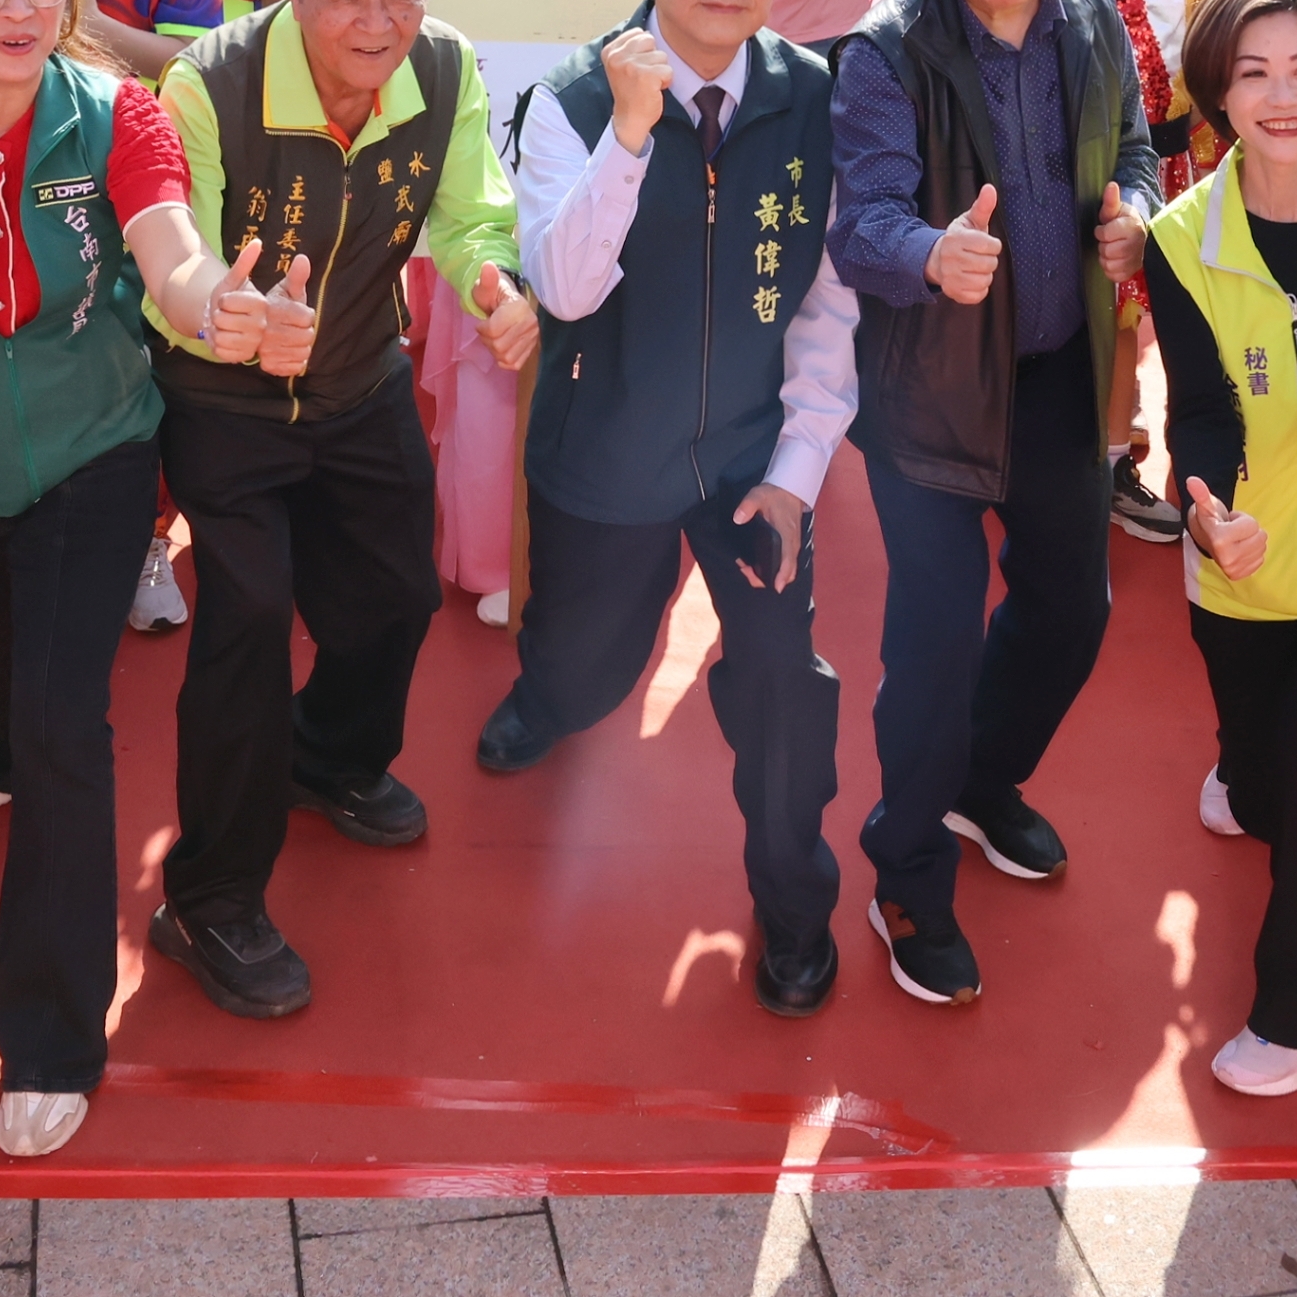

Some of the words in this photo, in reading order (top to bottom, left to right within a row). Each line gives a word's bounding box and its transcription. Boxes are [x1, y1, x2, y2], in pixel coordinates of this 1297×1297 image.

[54, 181, 96, 198] DPP
[785, 156, 810, 226] 市長
[753, 192, 784, 324] 黃偉哲
[1244, 346, 1270, 396] 秘書
